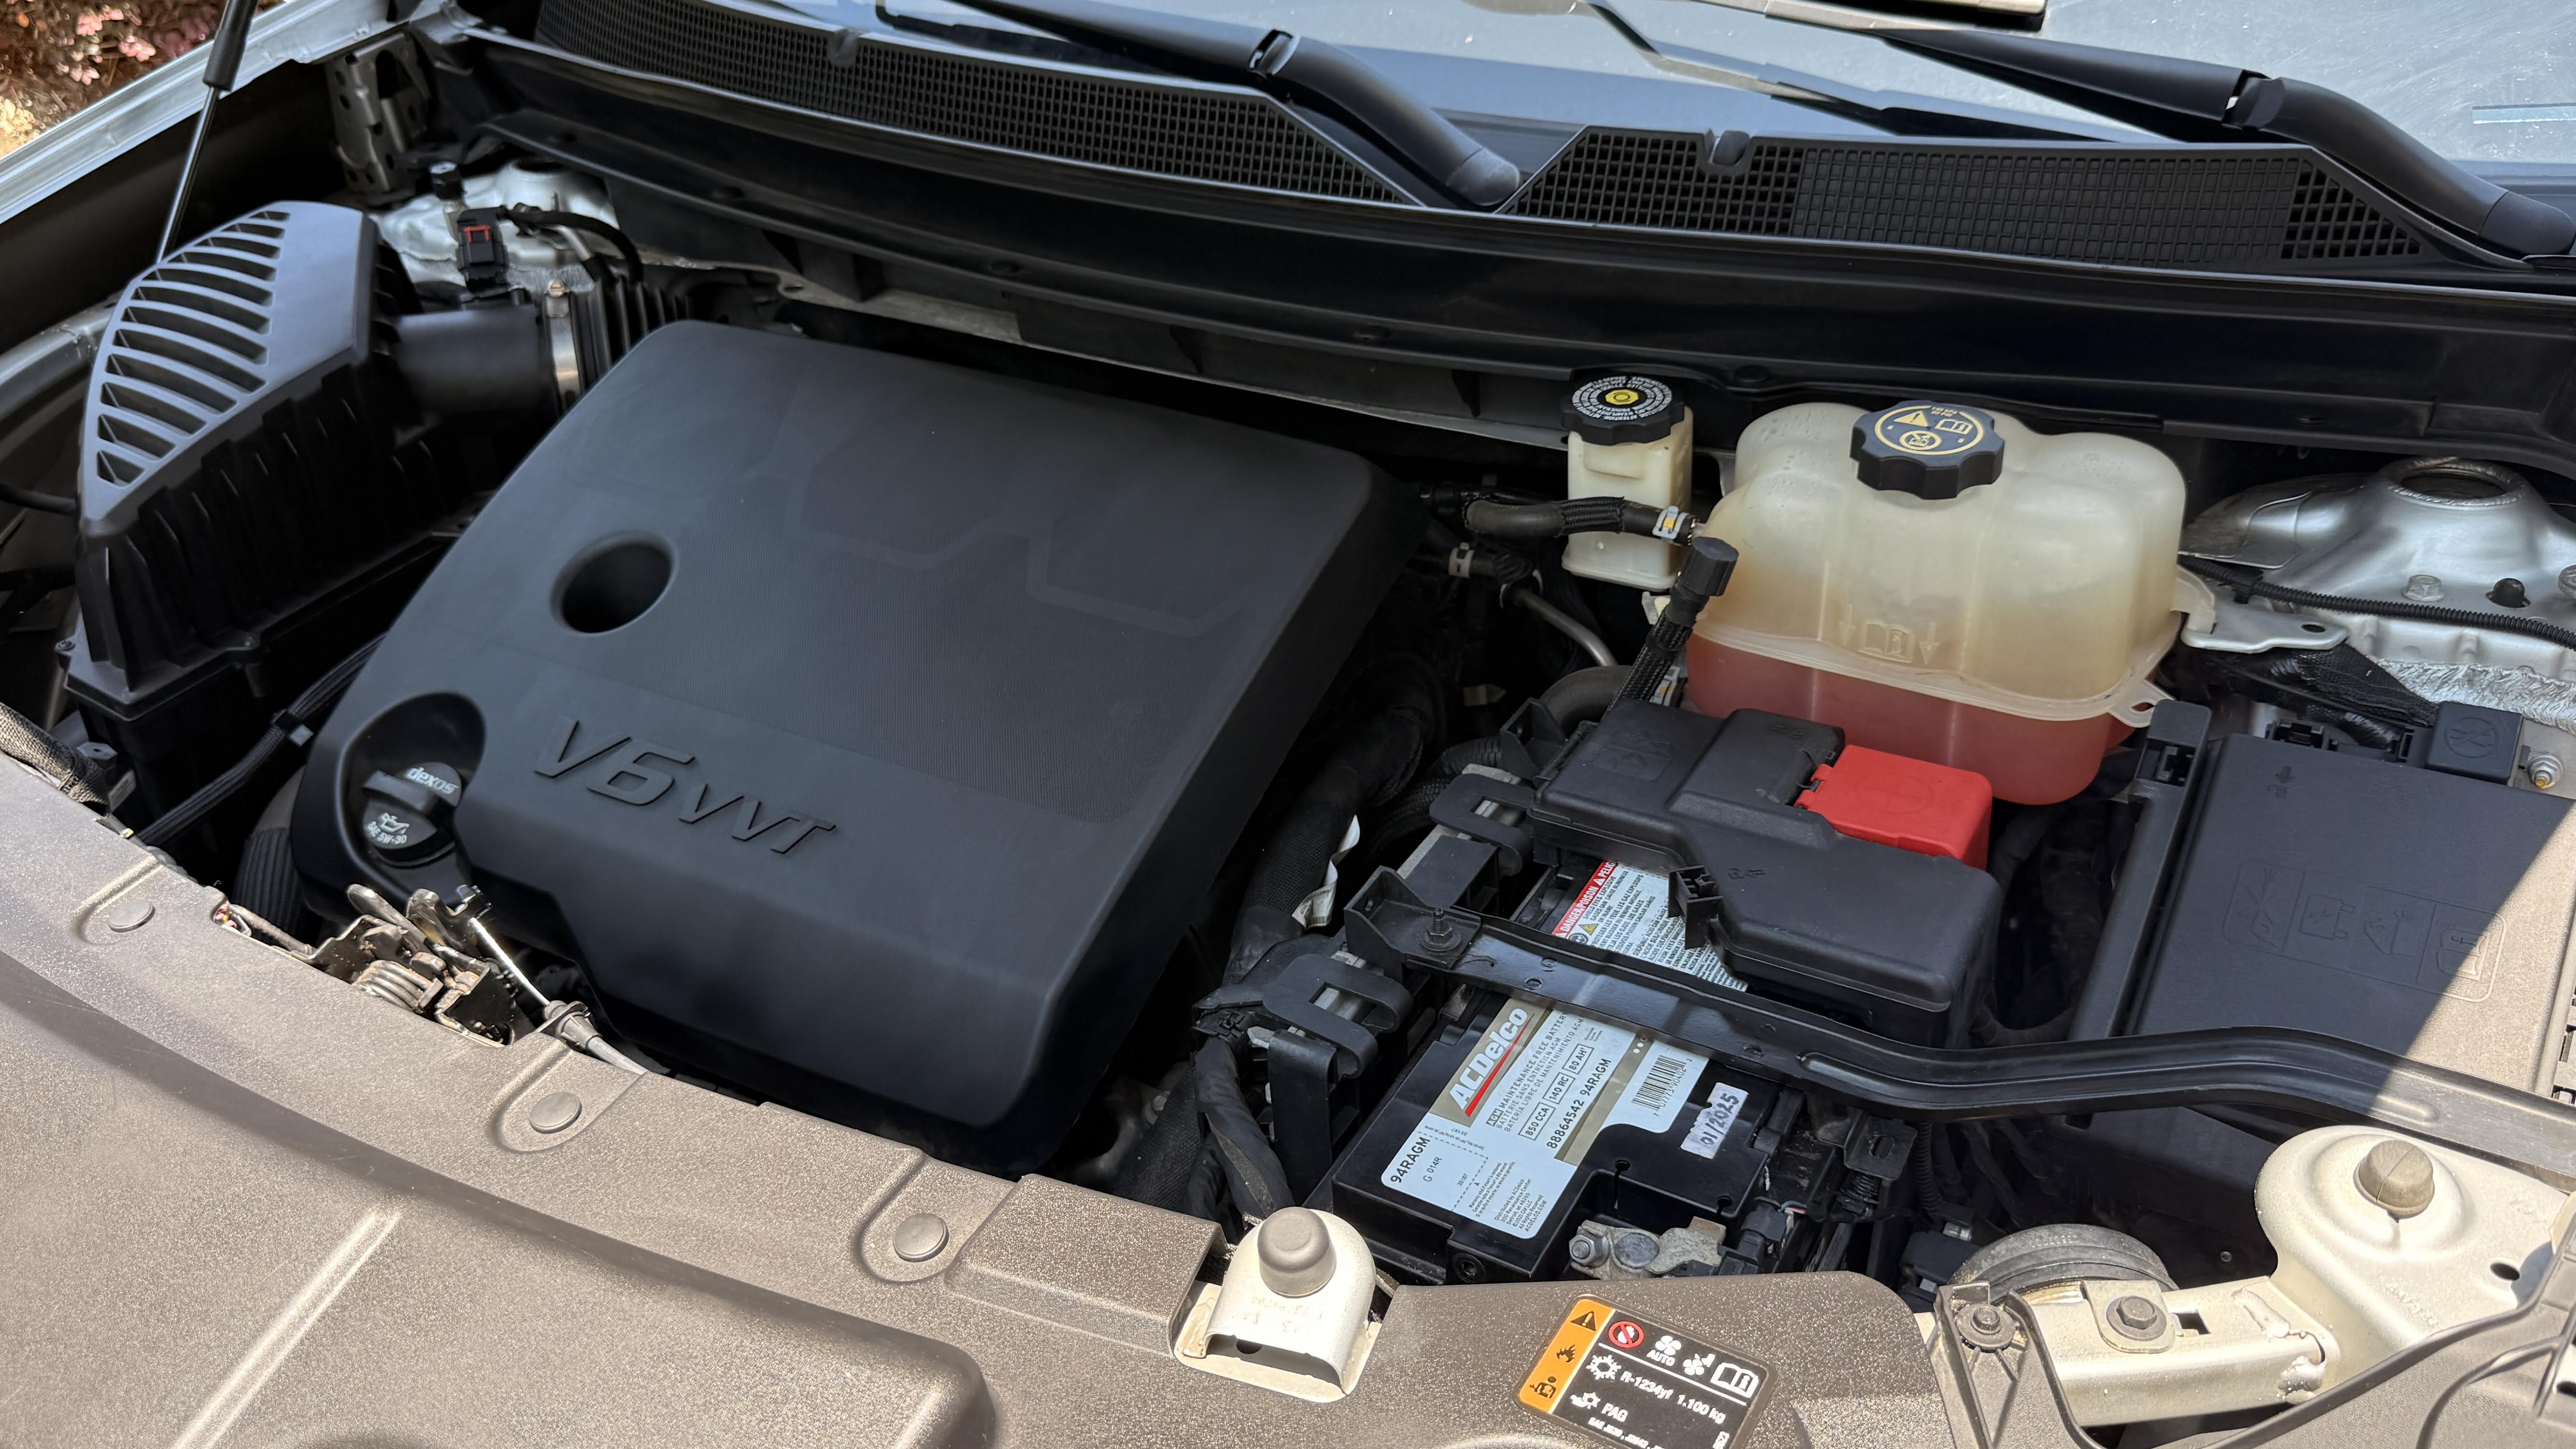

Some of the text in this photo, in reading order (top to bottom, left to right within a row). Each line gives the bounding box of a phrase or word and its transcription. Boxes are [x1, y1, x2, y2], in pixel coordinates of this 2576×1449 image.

[406, 767, 459, 794] dexos
[534, 717, 837, 855] V6 VVT
[367, 821, 408, 844] SAE 5W-30
[1559, 860, 1616, 932] DANGER/POISON PELIG
[1449, 1008, 1528, 1109] ACDelco
[1502, 1017, 1584, 1132] BATERÍA LIBRE DE MANTENIMIENTO AGM
[1486, 1108, 1503, 1126] AGM
[1498, 1059, 1537, 1108] MAINTENANCE
[1532, 1040, 1549, 1059] FREE
[1495, 1037, 1562, 1129] BATTERIE SANS ENTRETIEN AGM
[1524, 1121, 1539, 1136] 850
[1534, 1106, 1550, 1122] CCA
[1548, 1086, 1563, 1100] 140
[1557, 1076, 1570, 1087] RC
[1568, 1060, 1580, 1070] 80
[1544, 1057, 1612, 1149] 88864542 94RAGM
[1700, 1094, 1739, 1145] 01/2025
[1389, 1136, 1430, 1184] 94RAGM
[1422, 1156, 1443, 1182] G 014R
[1494, 1199, 1511, 1221] Distributed
[1510, 1178, 1525, 1195] ACDelco
[1505, 1191, 1524, 1214] Renaissance
[1520, 1178, 1533, 1192] Center
[1521, 1211, 1533, 1224] Rights
[1528, 1194, 1544, 1212] Reserved
[1523, 1199, 1548, 1232] ACDELCO.COM
[1524, 1199, 1533, 1208] LLC
[1647, 1350, 1675, 1366] AUTO
[1601, 1403, 1628, 1422] PAG
[1620, 1371, 1726, 1424] R-1234yf 1.100 kg
